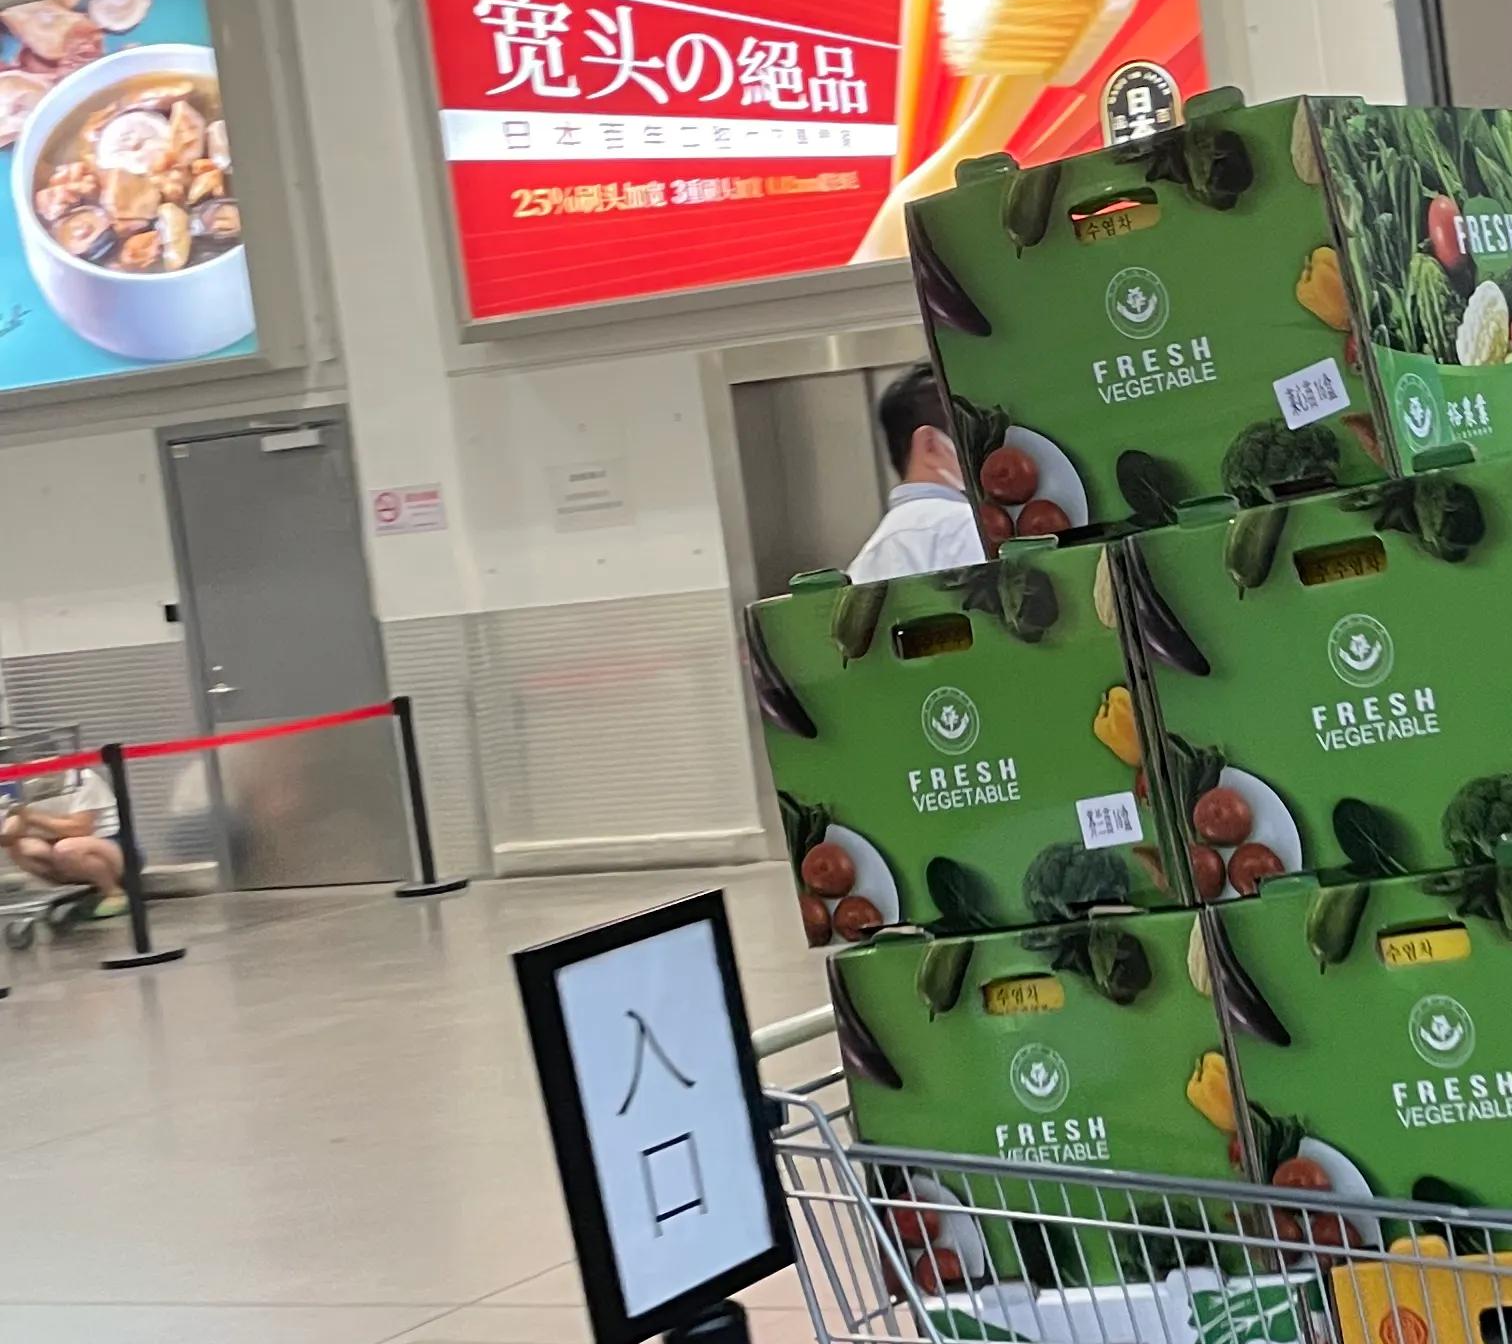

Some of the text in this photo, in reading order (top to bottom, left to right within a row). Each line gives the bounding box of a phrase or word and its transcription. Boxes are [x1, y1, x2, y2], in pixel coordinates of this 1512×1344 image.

[1092, 336, 1212, 384] FRESH
[1097, 361, 1217, 404] VEGETABLE
[1311, 687, 1436, 730] FRESH
[1315, 713, 1440, 751] VEGETABLE
[908, 758, 1017, 793] FRESH
[912, 781, 1021, 813] VEGETABLE
[615, 1007, 709, 1238] 入口
[995, 1116, 1106, 1148] FRESH
